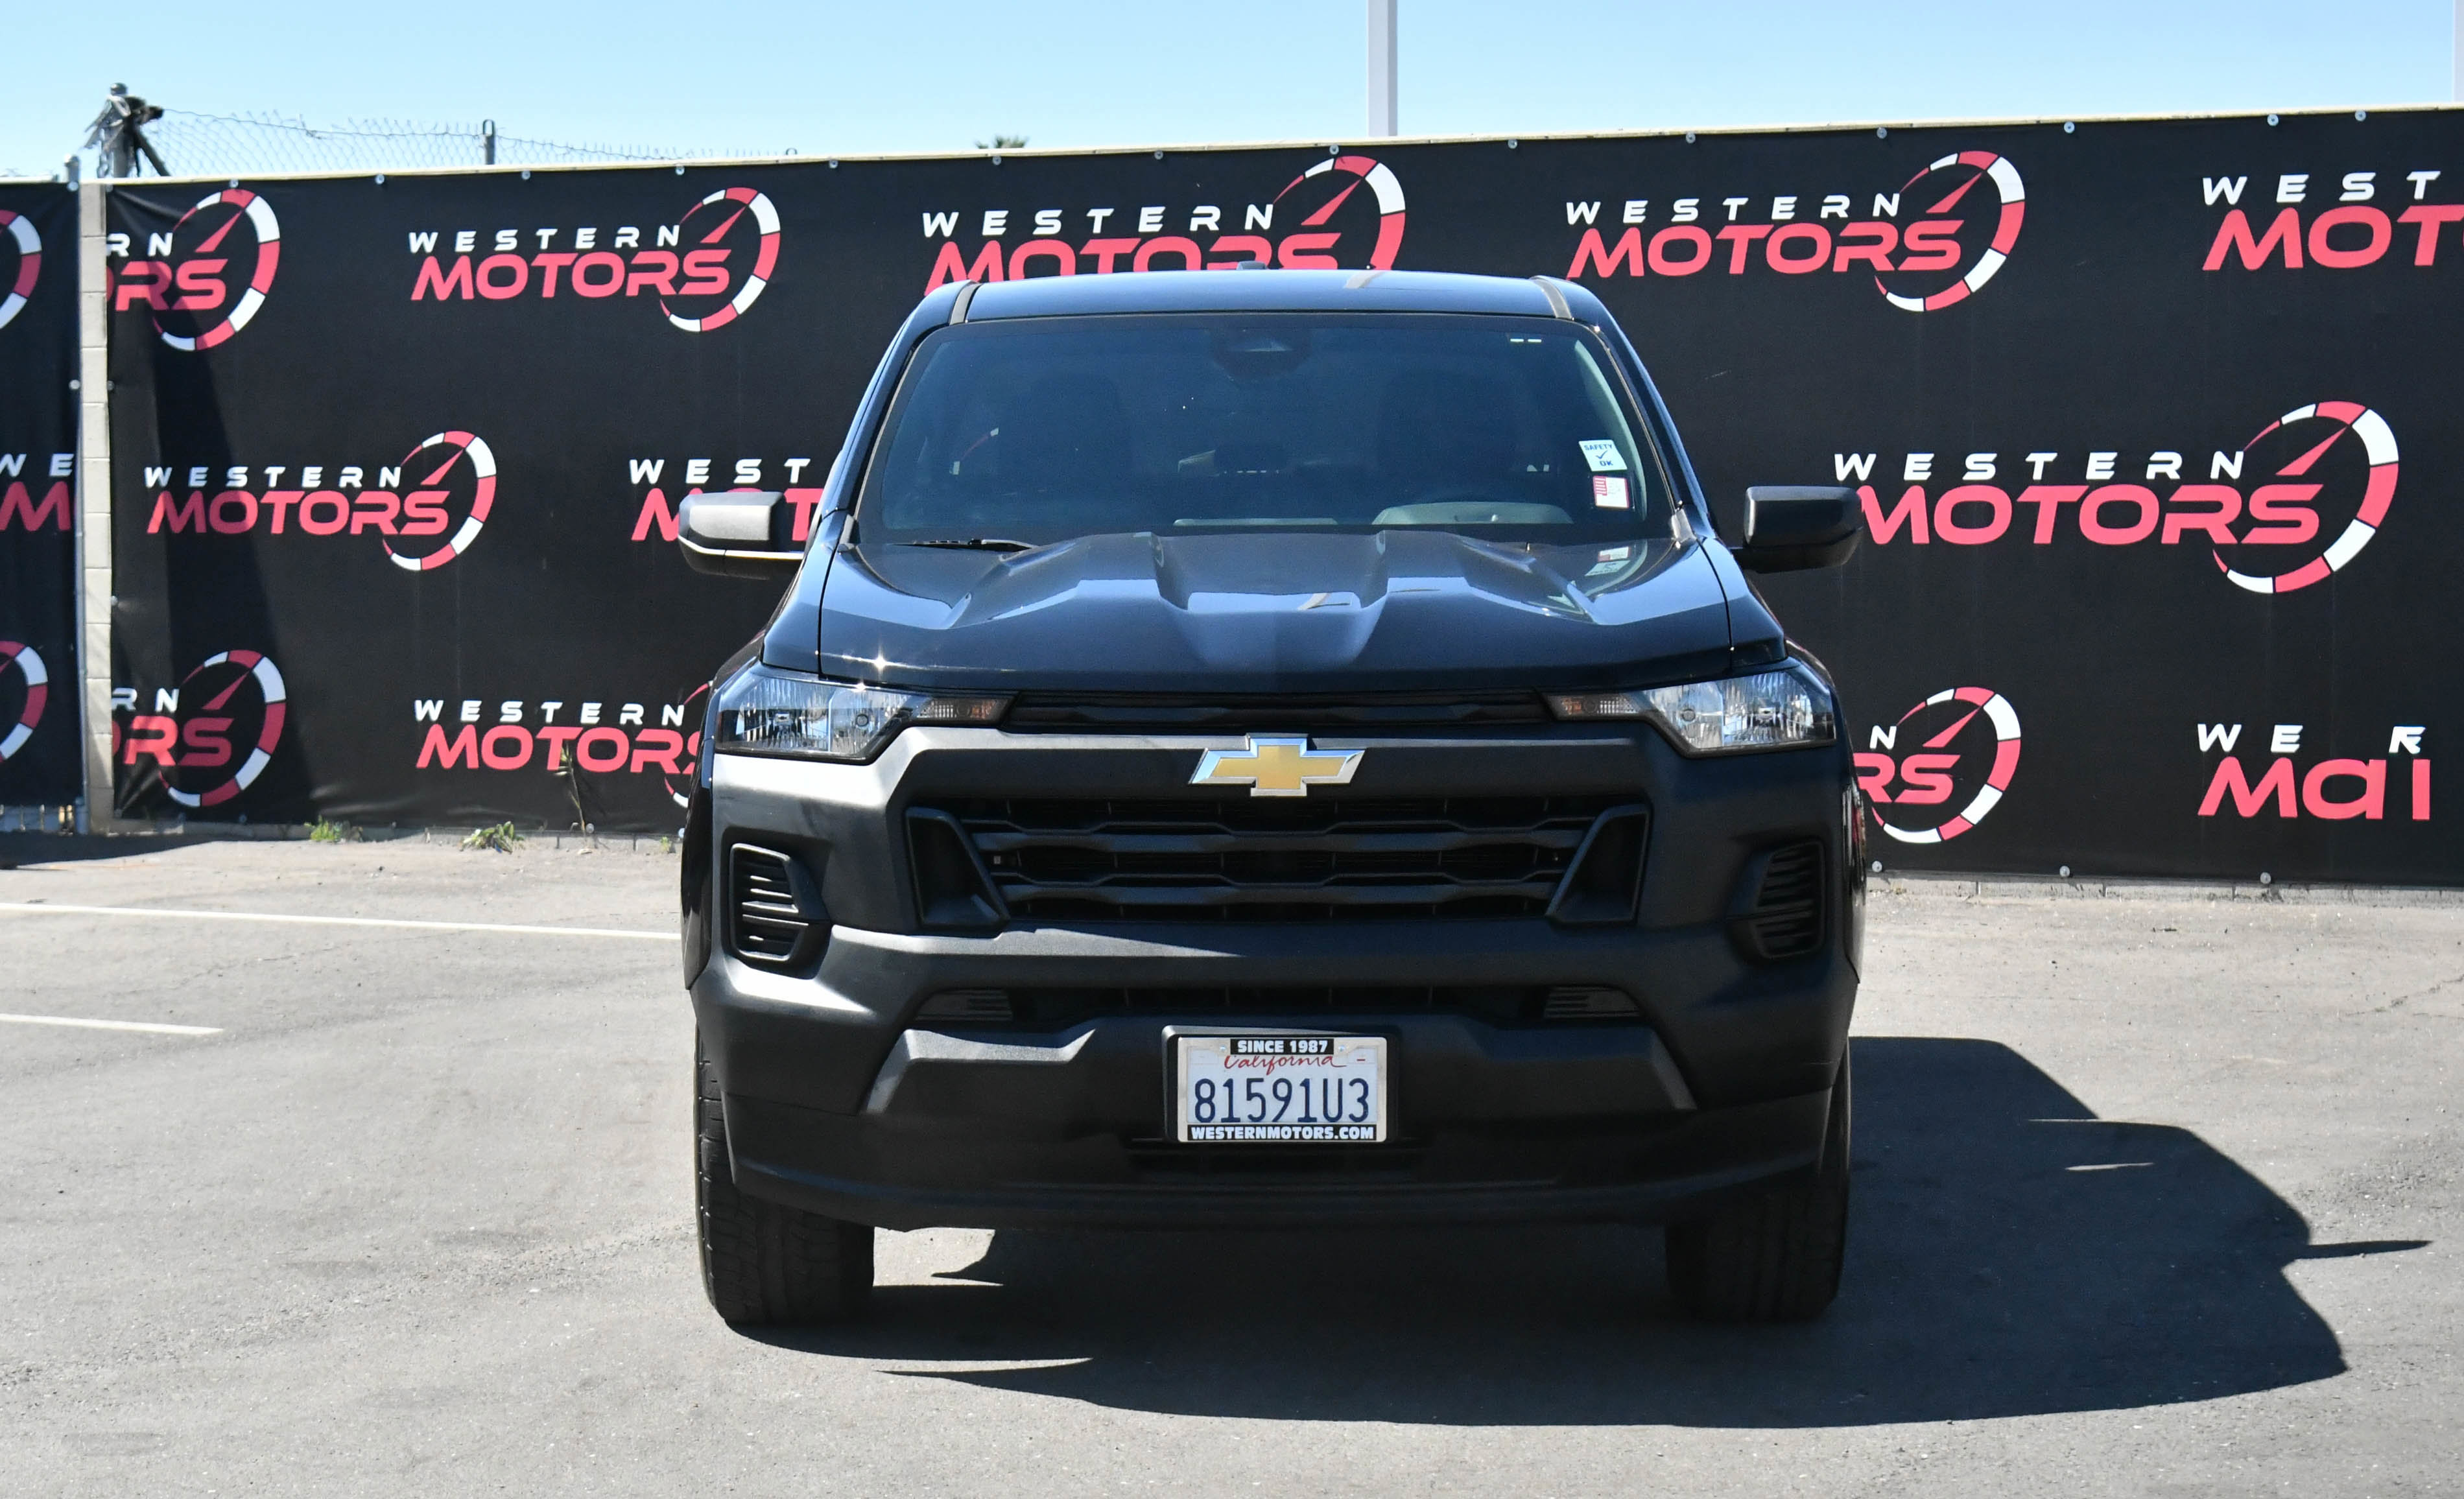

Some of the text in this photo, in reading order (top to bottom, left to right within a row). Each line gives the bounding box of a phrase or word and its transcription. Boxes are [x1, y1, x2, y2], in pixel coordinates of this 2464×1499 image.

[923, 204, 1273, 238] WESTERN
[1566, 193, 1900, 225] WESTERN
[409, 224, 680, 254] WESTERN
[1567, 220, 1964, 279] MOTORS
[2202, 204, 2464, 271] MOT
[411, 248, 731, 301] MOTORS
[924, 232, 1342, 296] MOTORS
[145, 466, 401, 488] WESTERN
[1834, 451, 2244, 481] WESTERN
[147, 490, 451, 535] MOTORS
[1856, 484, 2323, 545] MOTORS
[414, 700, 685, 726] WESTERN
[1237, 1039, 1329, 1054] SINCE 1987
[1224, 1055, 1347, 1076] California
[1194, 1077, 1369, 1123] 81591U3
[1191, 1126, 1374, 1140] WESTERNMOTORS.COM
